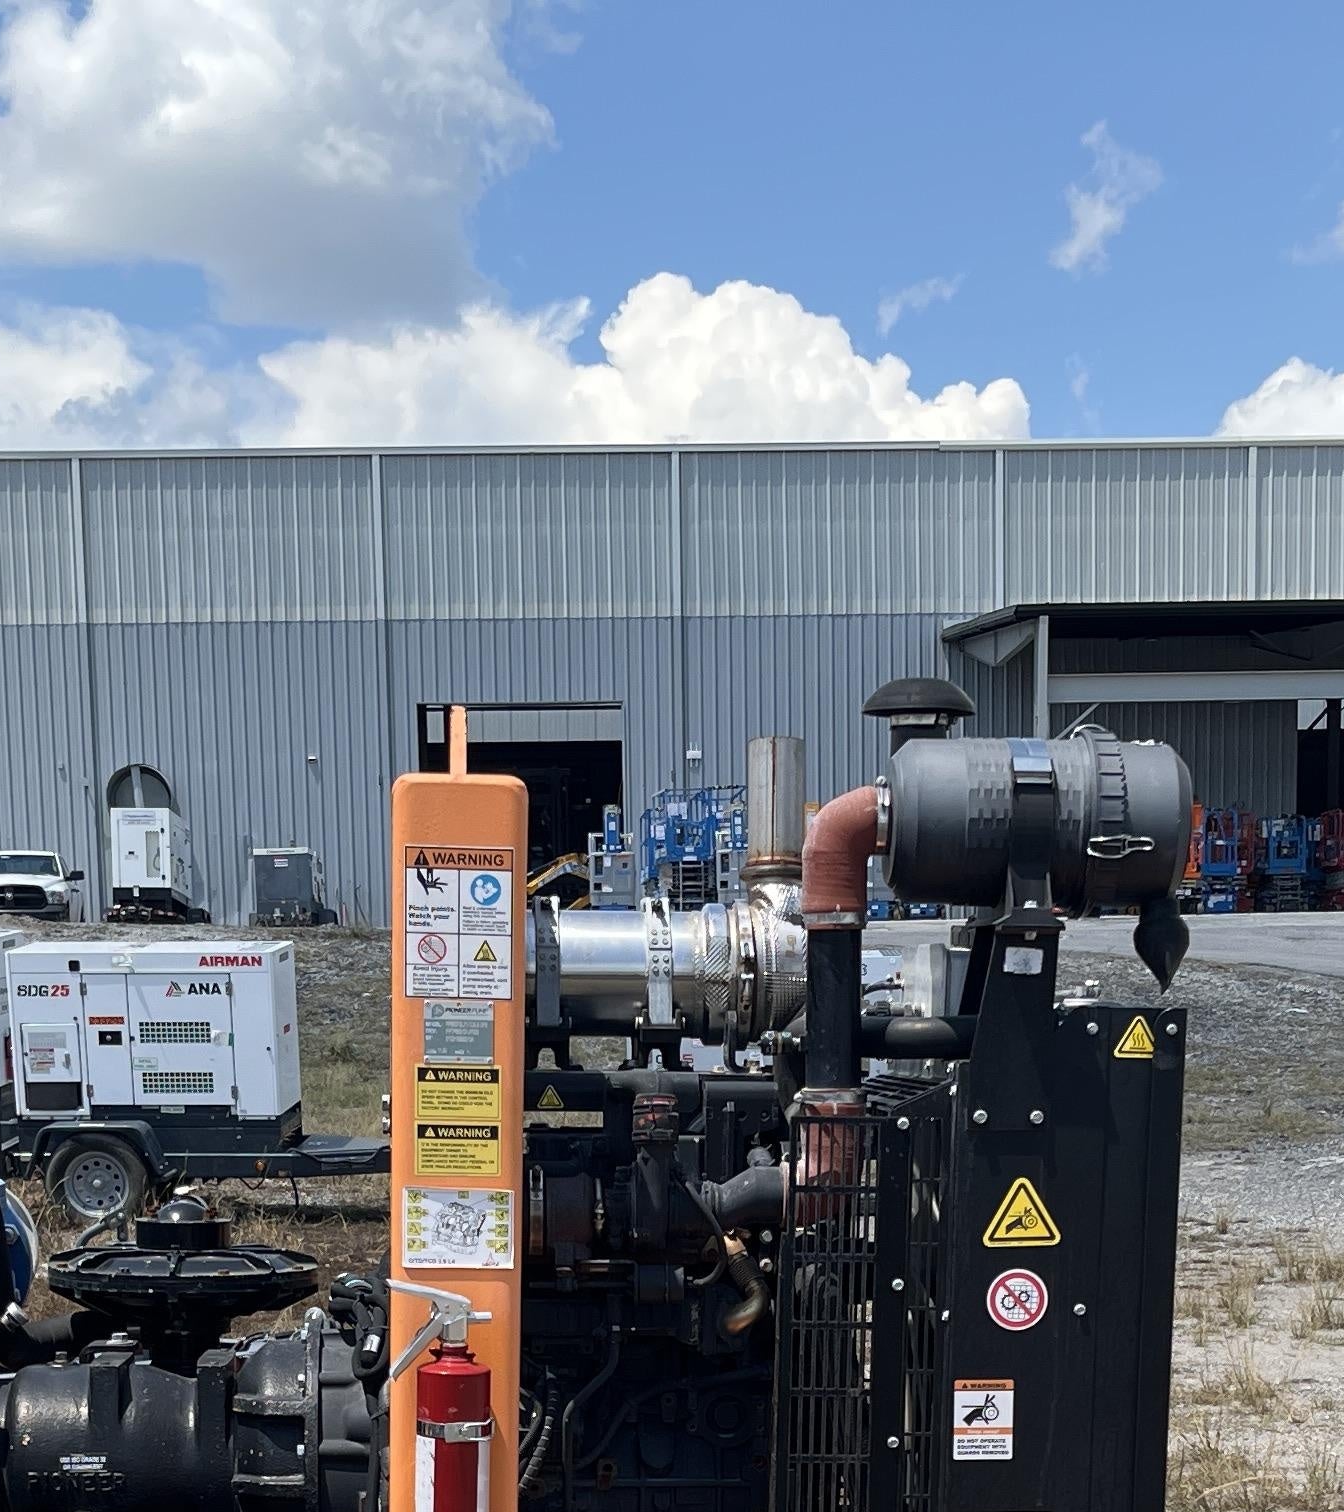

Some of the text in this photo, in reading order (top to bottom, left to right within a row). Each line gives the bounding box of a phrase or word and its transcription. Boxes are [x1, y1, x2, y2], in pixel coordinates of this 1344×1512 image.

[433, 853, 504, 867] WARNING
[199, 956, 262, 967] AIRMAN
[188, 982, 222, 996] ANA
[438, 1071, 492, 1082] WARNING
[438, 1127, 491, 1138] WARNING
